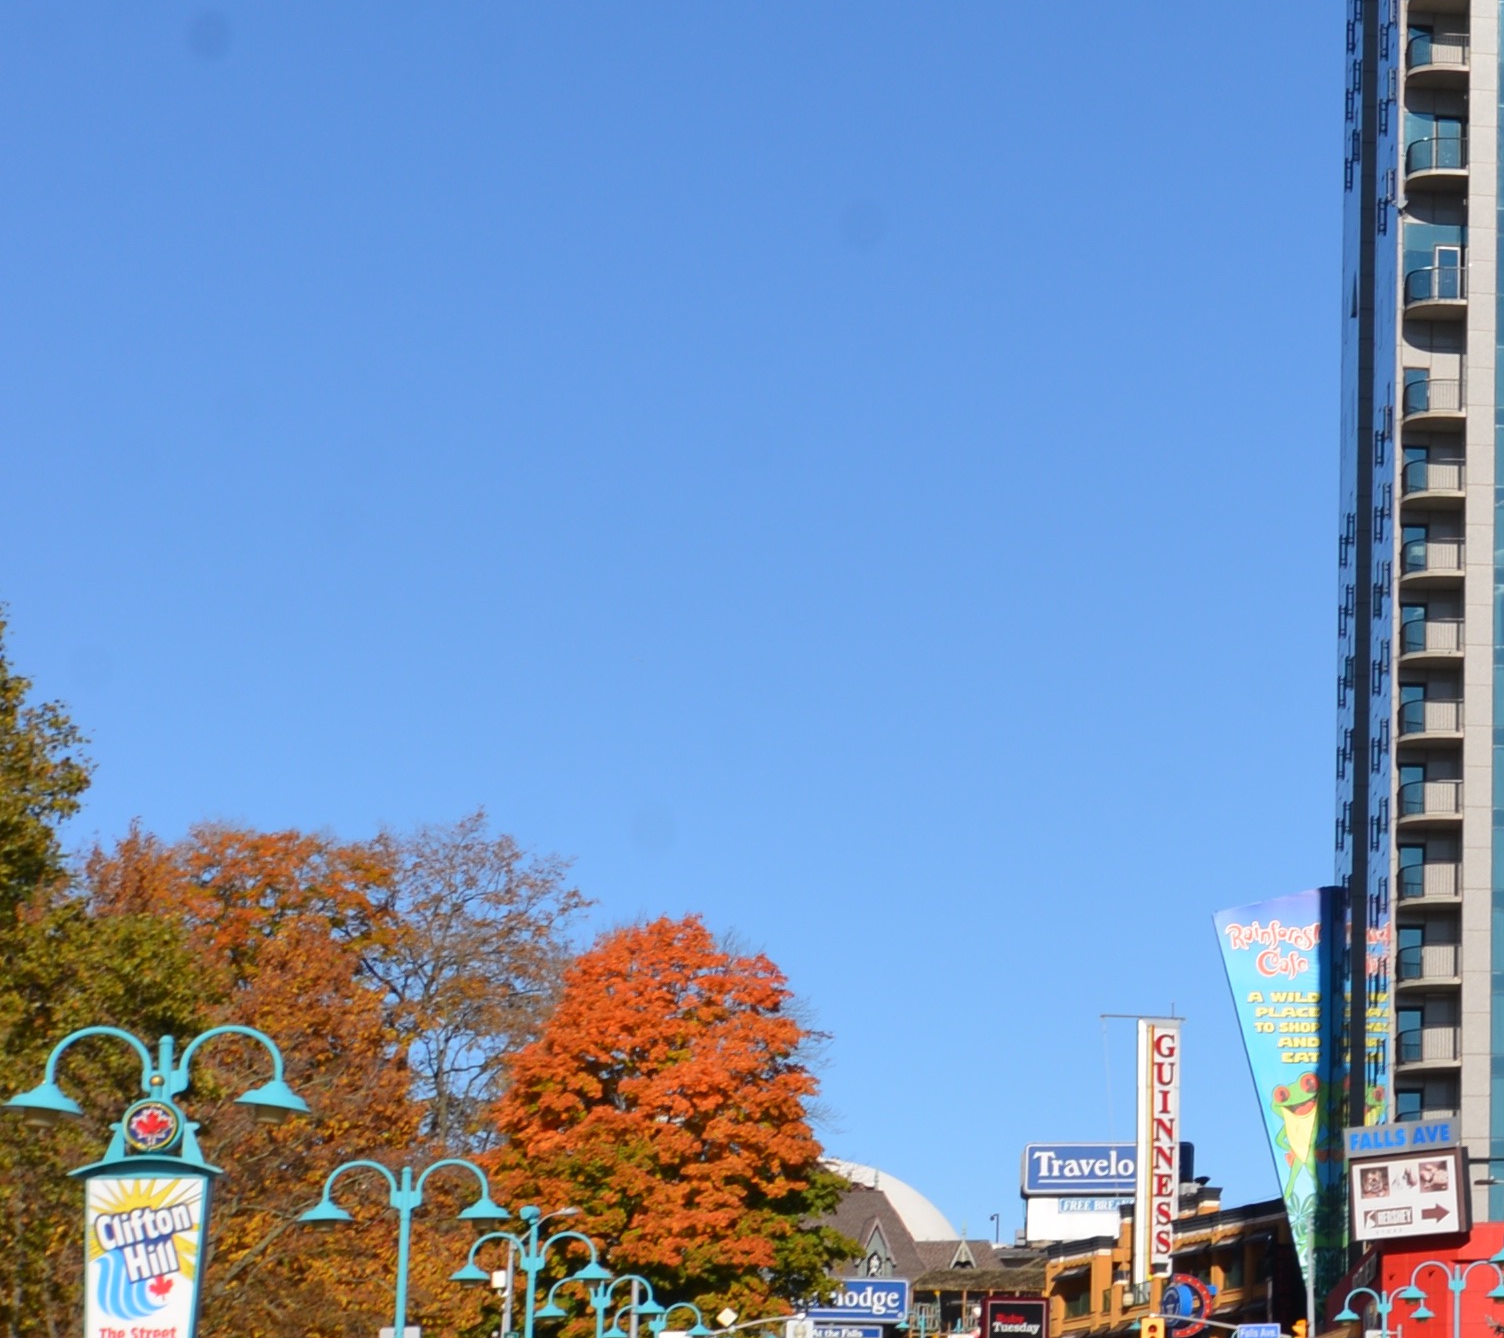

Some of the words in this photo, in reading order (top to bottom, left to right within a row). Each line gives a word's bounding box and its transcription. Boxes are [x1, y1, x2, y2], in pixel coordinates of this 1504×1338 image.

[1225, 919, 1321, 951] Rainforest
[1247, 991, 1265, 1003] A
[1270, 991, 1321, 1003] WILD
[1254, 1006, 1320, 1018] PLACE
[1253, 1021, 1275, 1034] TO
[1278, 1021, 1320, 1034] SHOP
[1277, 1037, 1321, 1048] AND
[1280, 1052, 1320, 1063] EAT
[1153, 1033, 1176, 1256] GUINNESS
[1349, 1128, 1407, 1152] FALLS
[1412, 1124, 1451, 1145] AVE
[1033, 1149, 1135, 1178] Travelo
[94, 1202, 193, 1252] Clifton
[122, 1235, 180, 1285] Hill
[992, 1321, 1041, 1336] Tuesday
[1240, 1327, 1259, 1338] Falls
